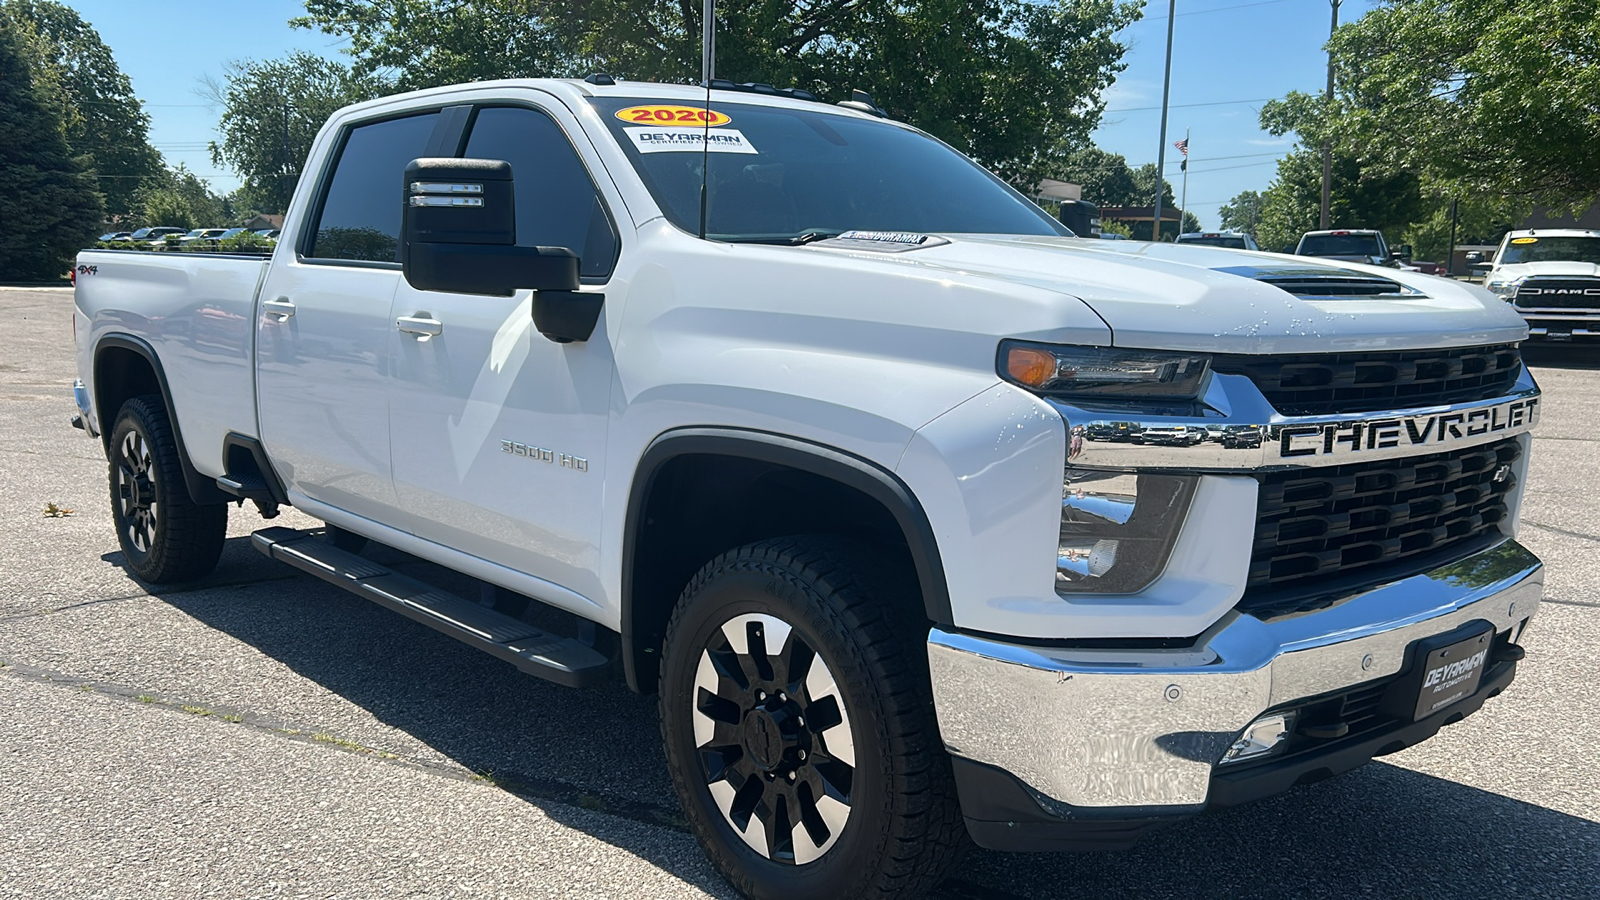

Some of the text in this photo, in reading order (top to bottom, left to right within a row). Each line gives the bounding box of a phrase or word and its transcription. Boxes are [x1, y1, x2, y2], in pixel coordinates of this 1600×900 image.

[631, 109, 718, 122] 2020
[639, 133, 741, 142] DEYARMAN
[1280, 399, 1538, 457] CHEVROLET
[501, 439, 588, 472] 3500 HD
[1424, 649, 1487, 688] DEYARMAN
[1433, 671, 1473, 693] AUTOMOTIVE
